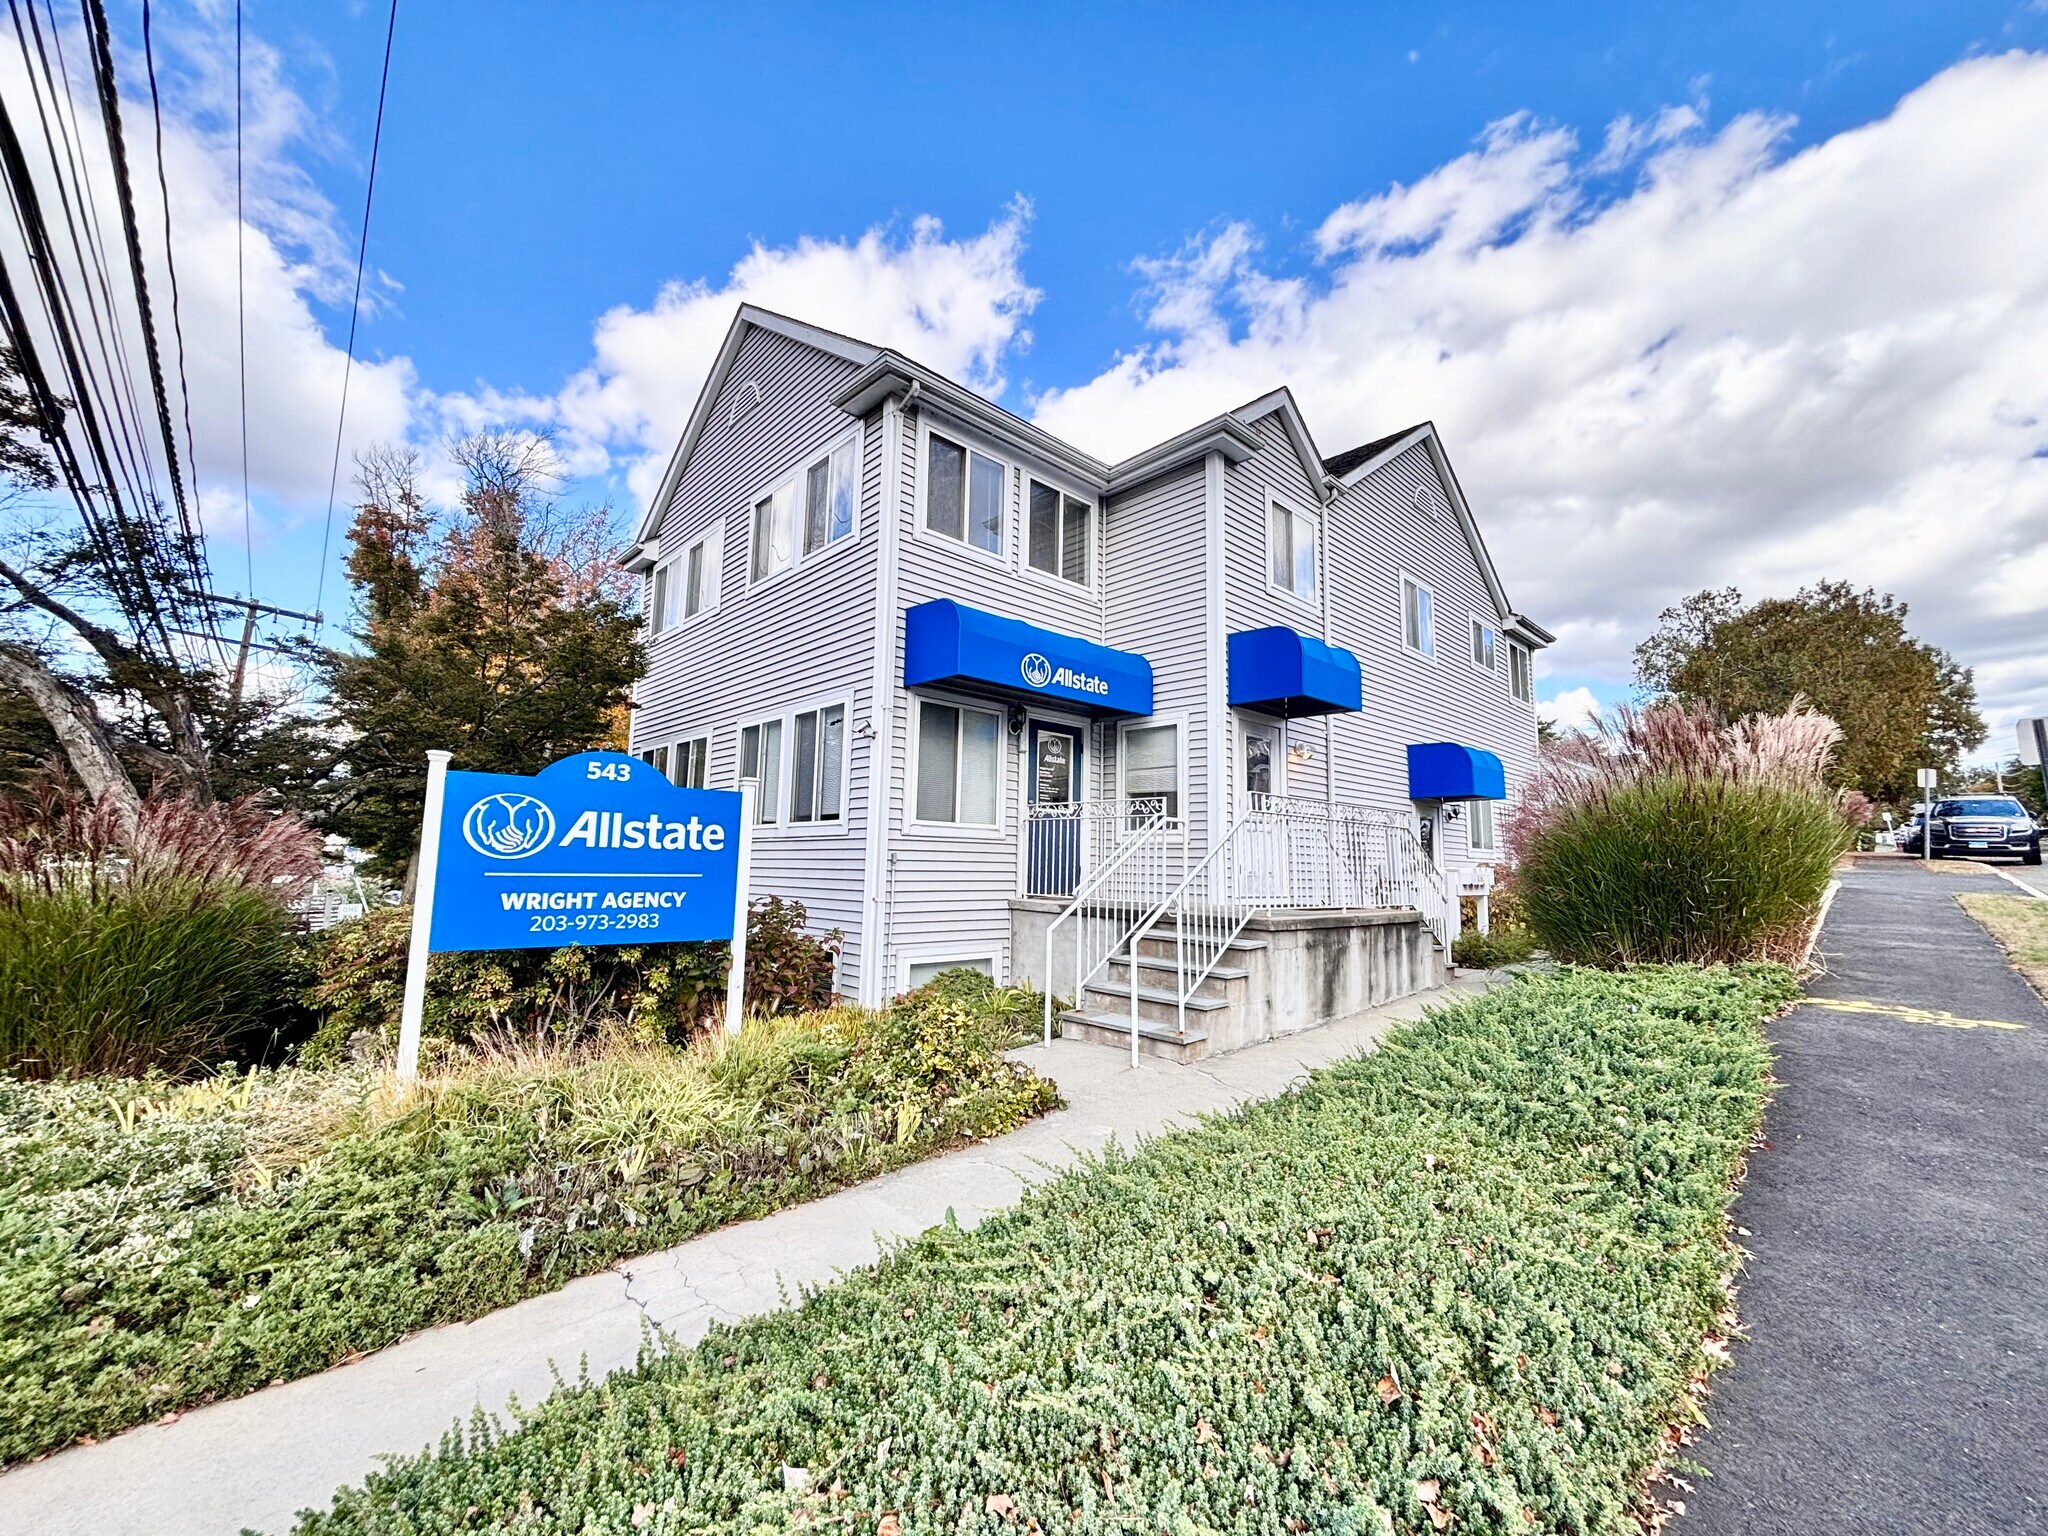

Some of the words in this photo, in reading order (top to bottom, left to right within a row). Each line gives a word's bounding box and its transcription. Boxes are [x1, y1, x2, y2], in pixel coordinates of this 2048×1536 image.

[1051, 667, 1109, 695] Allstate
[586, 761, 631, 782] 543
[558, 810, 726, 851] Allstate
[501, 892, 598, 911] WRIGHT
[601, 891, 687, 909] AGENCY
[529, 913, 660, 932] 203-973-2983
